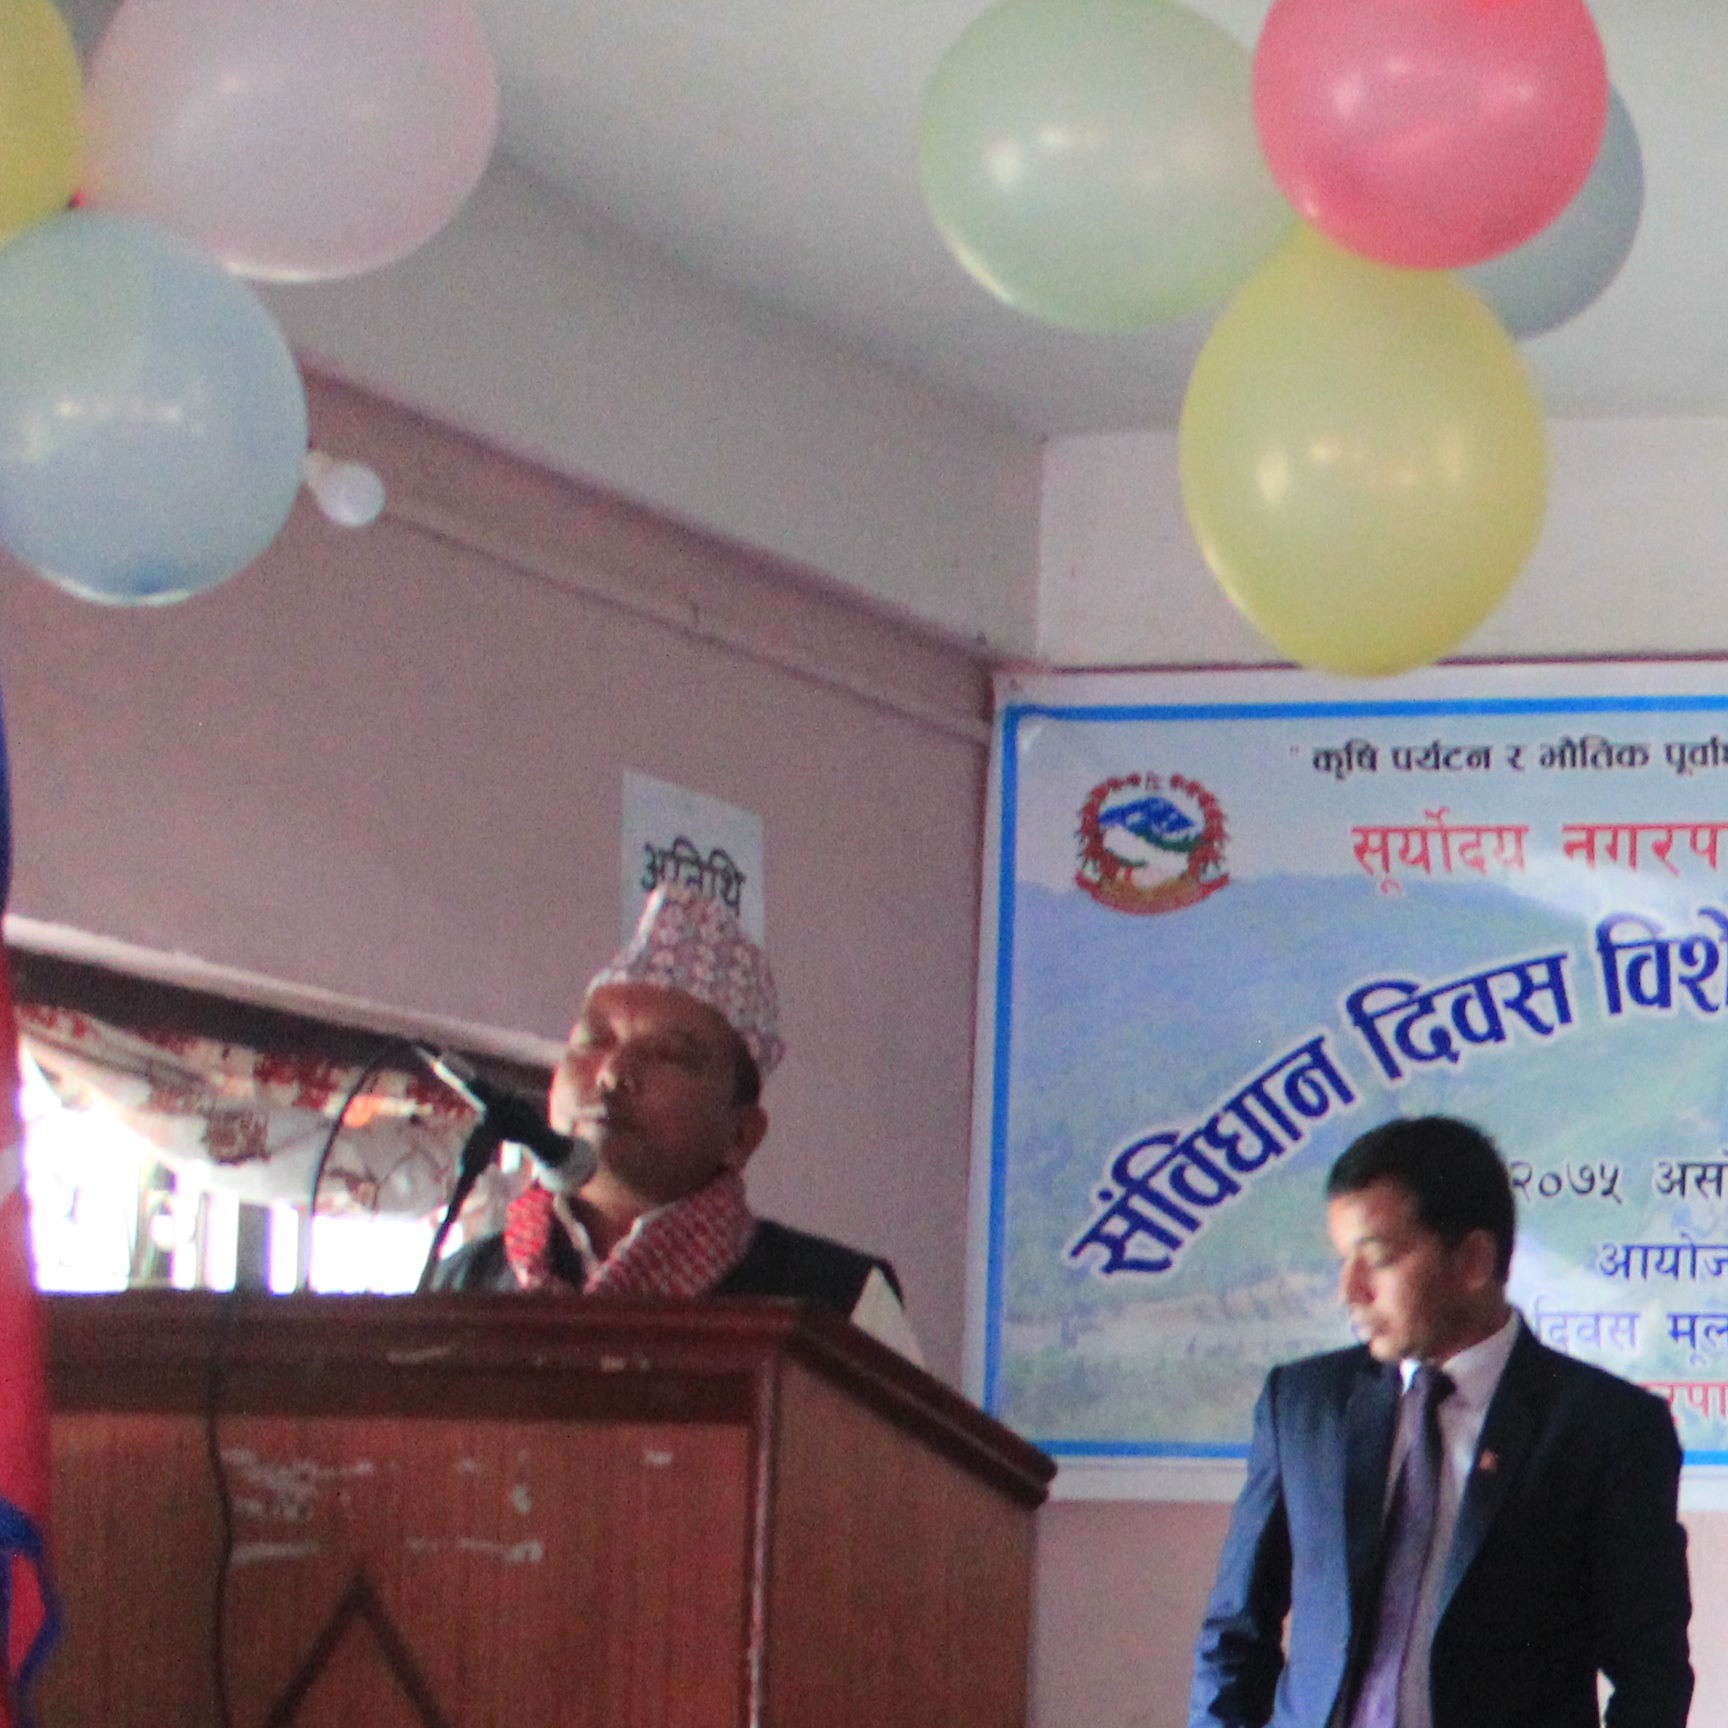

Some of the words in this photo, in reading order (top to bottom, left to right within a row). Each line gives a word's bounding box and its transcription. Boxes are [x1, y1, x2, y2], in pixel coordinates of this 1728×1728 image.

[1312, 738, 1378, 781] कृषि
[1391, 739, 1493, 773] पर्यटन
[1505, 744, 1526, 772] र
[1539, 734, 1650, 770] भौतिक
[1352, 806, 1530, 894] सूर्योदय
[1070, 1034, 1357, 1275] संविधान
[1345, 952, 1572, 1082] दिवस
[1511, 1160, 1623, 1204] २०७५
